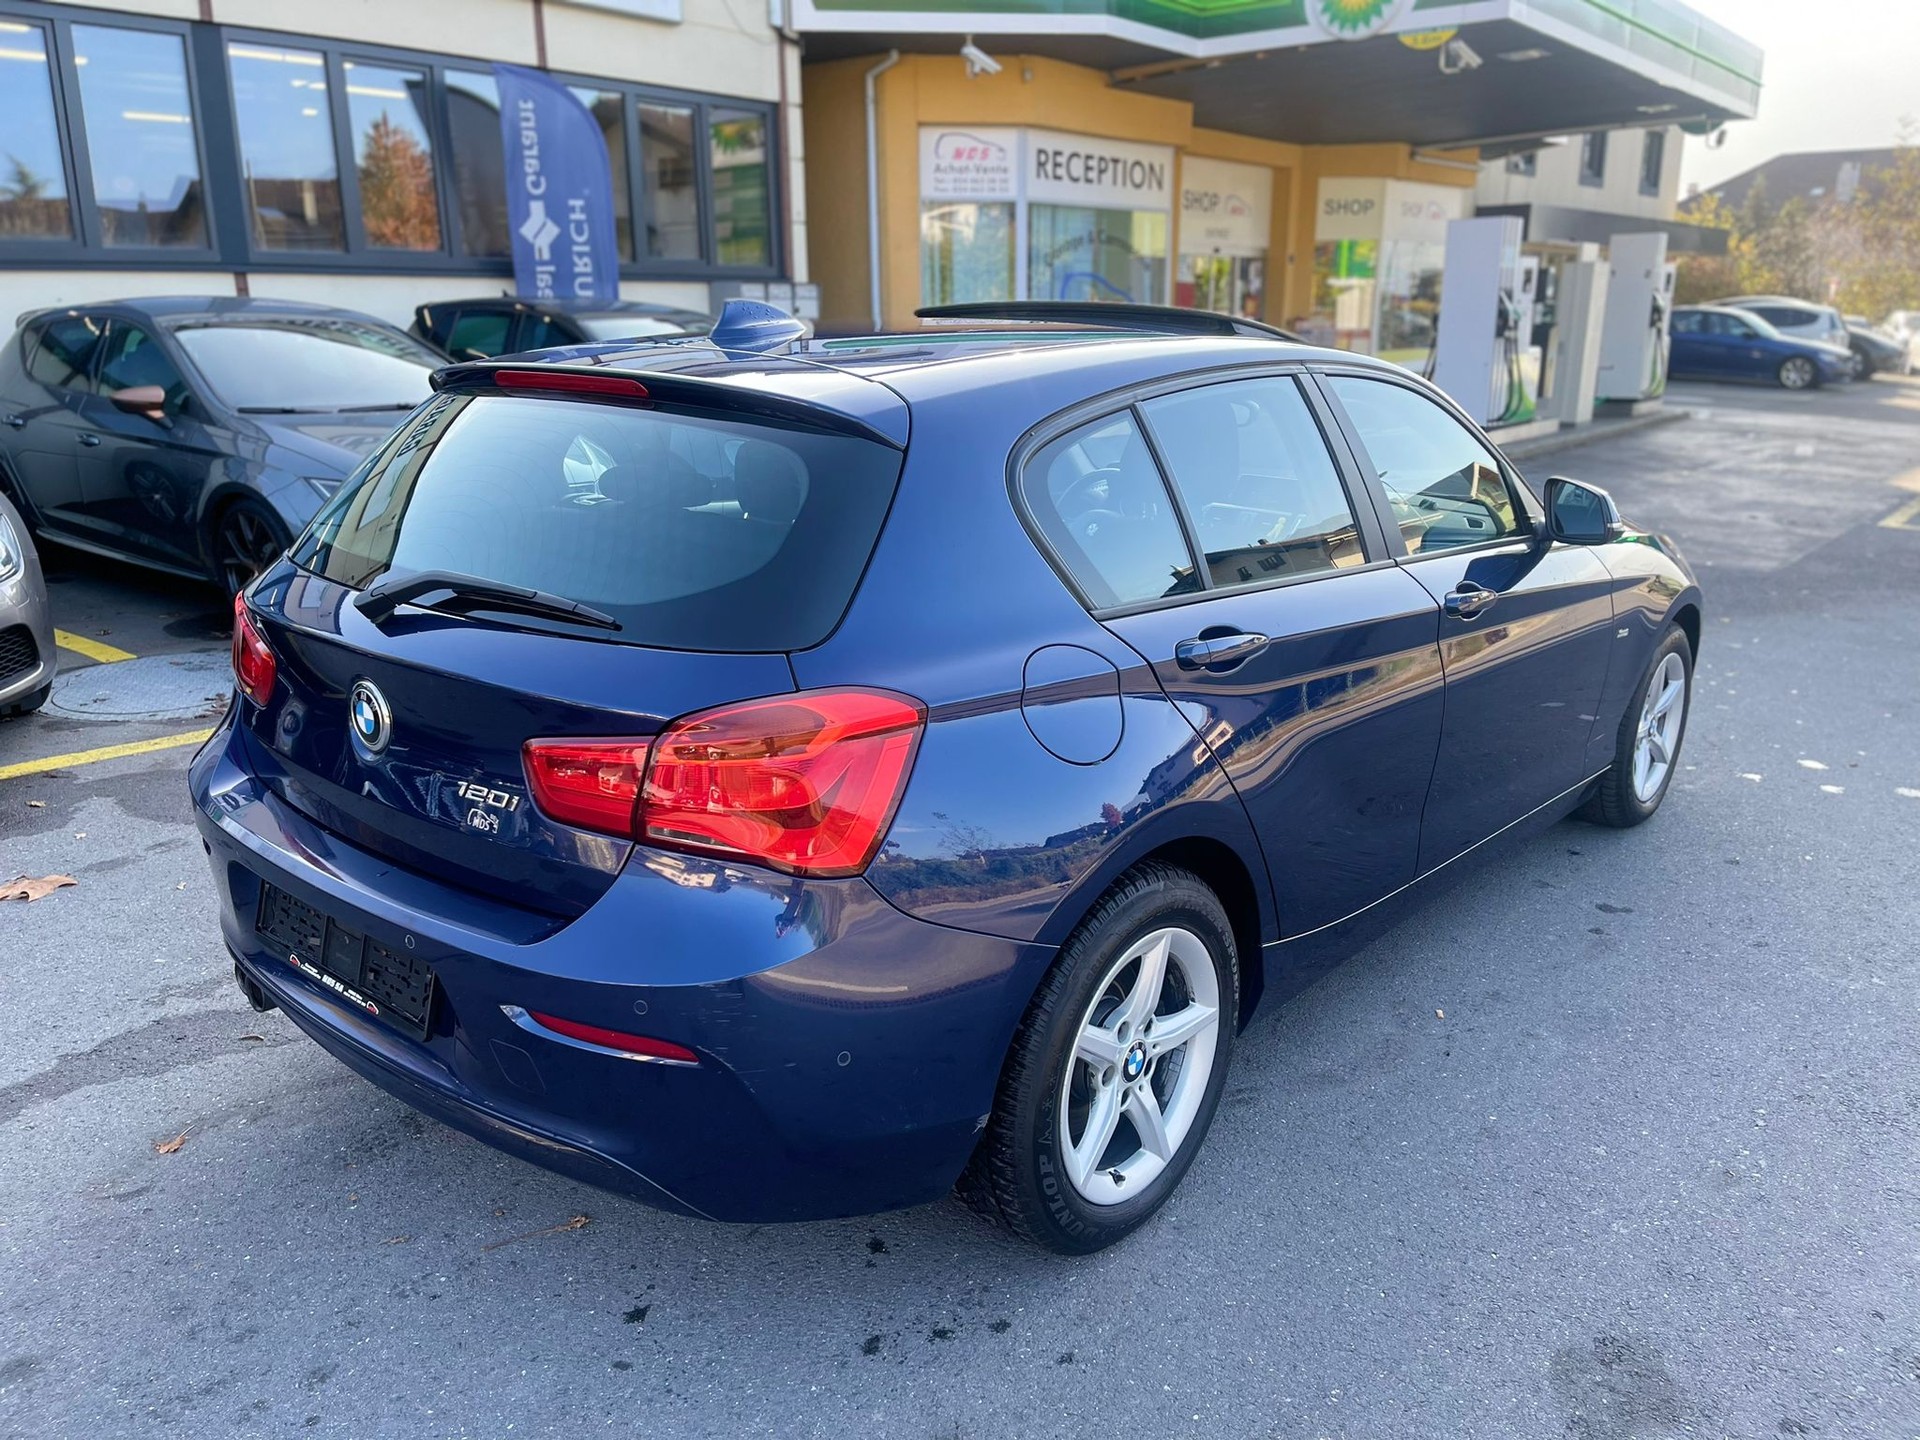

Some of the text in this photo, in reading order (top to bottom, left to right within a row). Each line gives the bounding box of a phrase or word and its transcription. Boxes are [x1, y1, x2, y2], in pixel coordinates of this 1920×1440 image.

[1036, 148, 1164, 190] RECEPTION
[1183, 188, 1219, 214] SHOP
[1323, 198, 1374, 217] SHOP
[457, 780, 520, 812] 120i
[472, 816, 491, 831] MDS
[1039, 1154, 1099, 1239] DUNLOP
